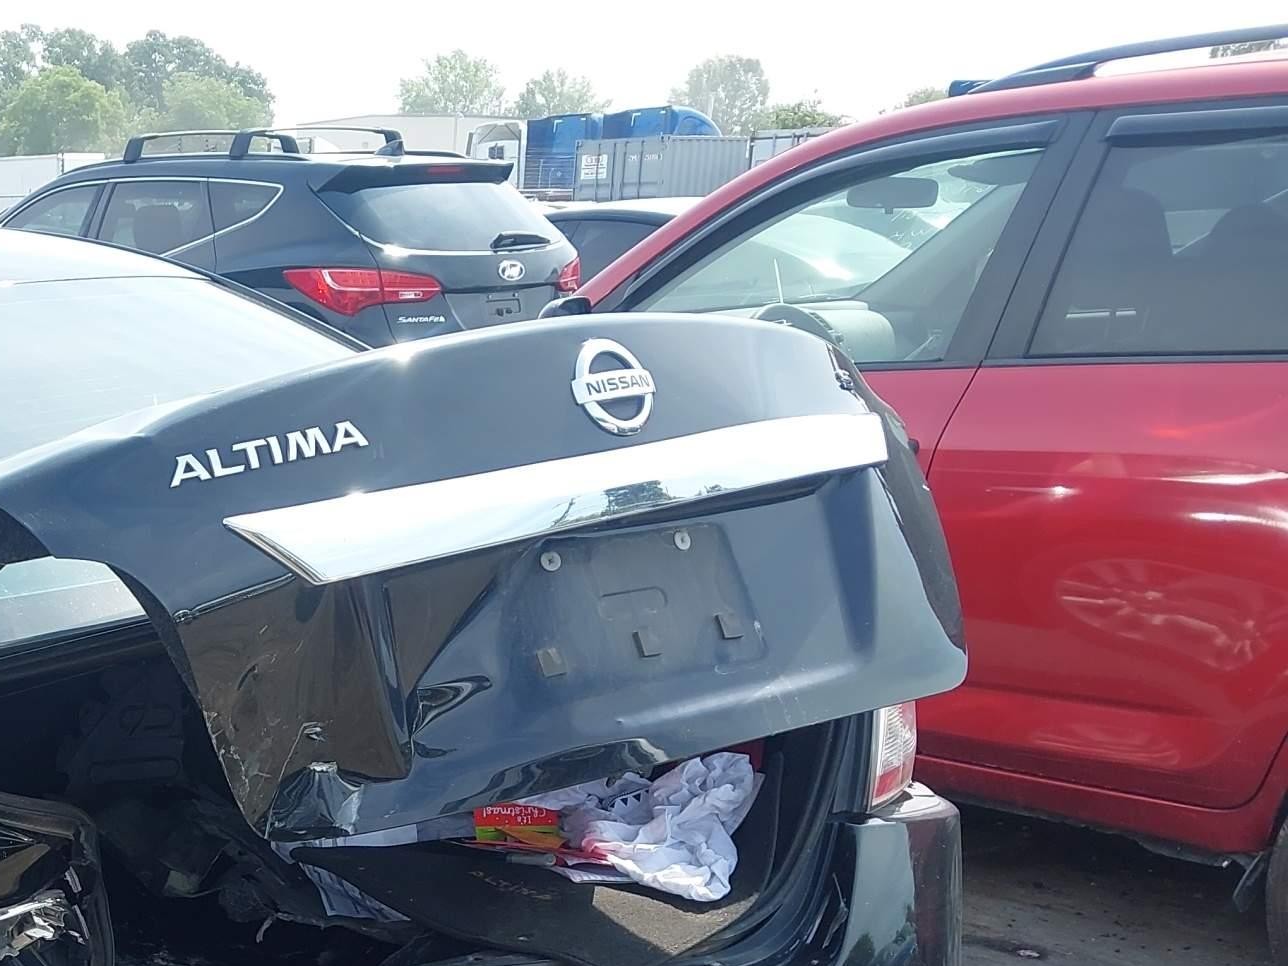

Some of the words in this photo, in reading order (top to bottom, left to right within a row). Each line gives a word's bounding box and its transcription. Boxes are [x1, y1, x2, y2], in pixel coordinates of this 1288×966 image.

[585, 374, 650, 396] NISSAN
[170, 420, 369, 488] ALTIMA
[483, 806, 546, 818] Christmas!
